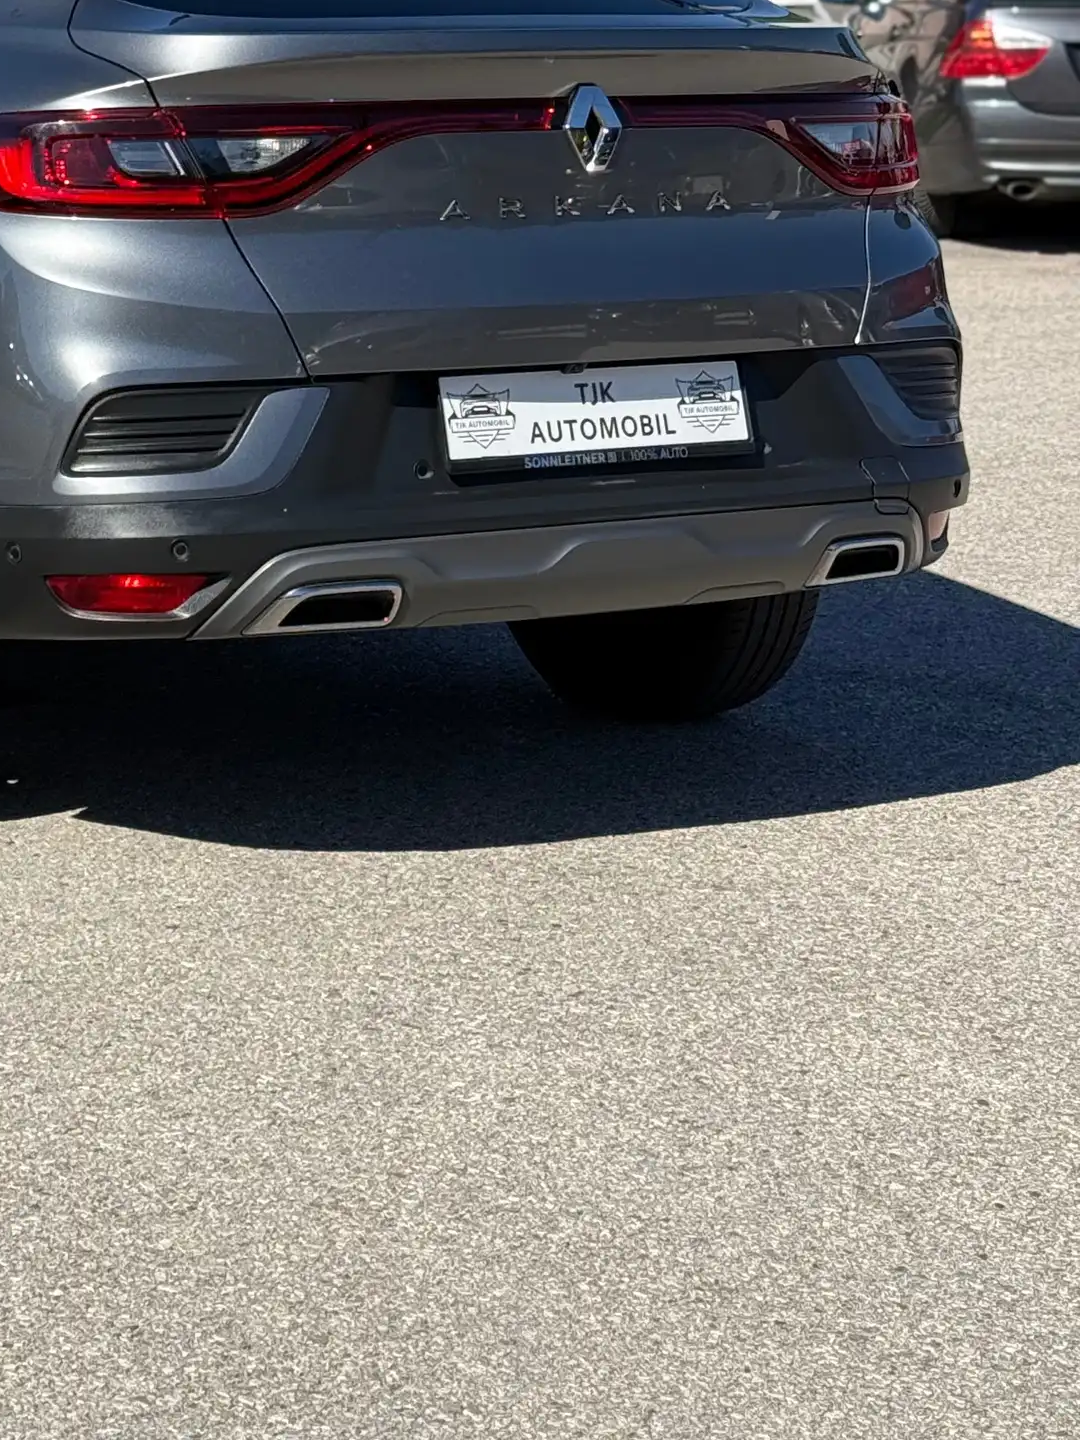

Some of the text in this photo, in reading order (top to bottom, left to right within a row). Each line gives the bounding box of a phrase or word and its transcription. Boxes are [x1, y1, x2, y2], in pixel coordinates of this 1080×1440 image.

[439, 190, 731, 221] ARKANA
[574, 381, 616, 406] TJK
[530, 412, 677, 444] AUTOMOBIL
[524, 452, 606, 469] SONNLEITNER
[660, 446, 689, 460] AUTO
